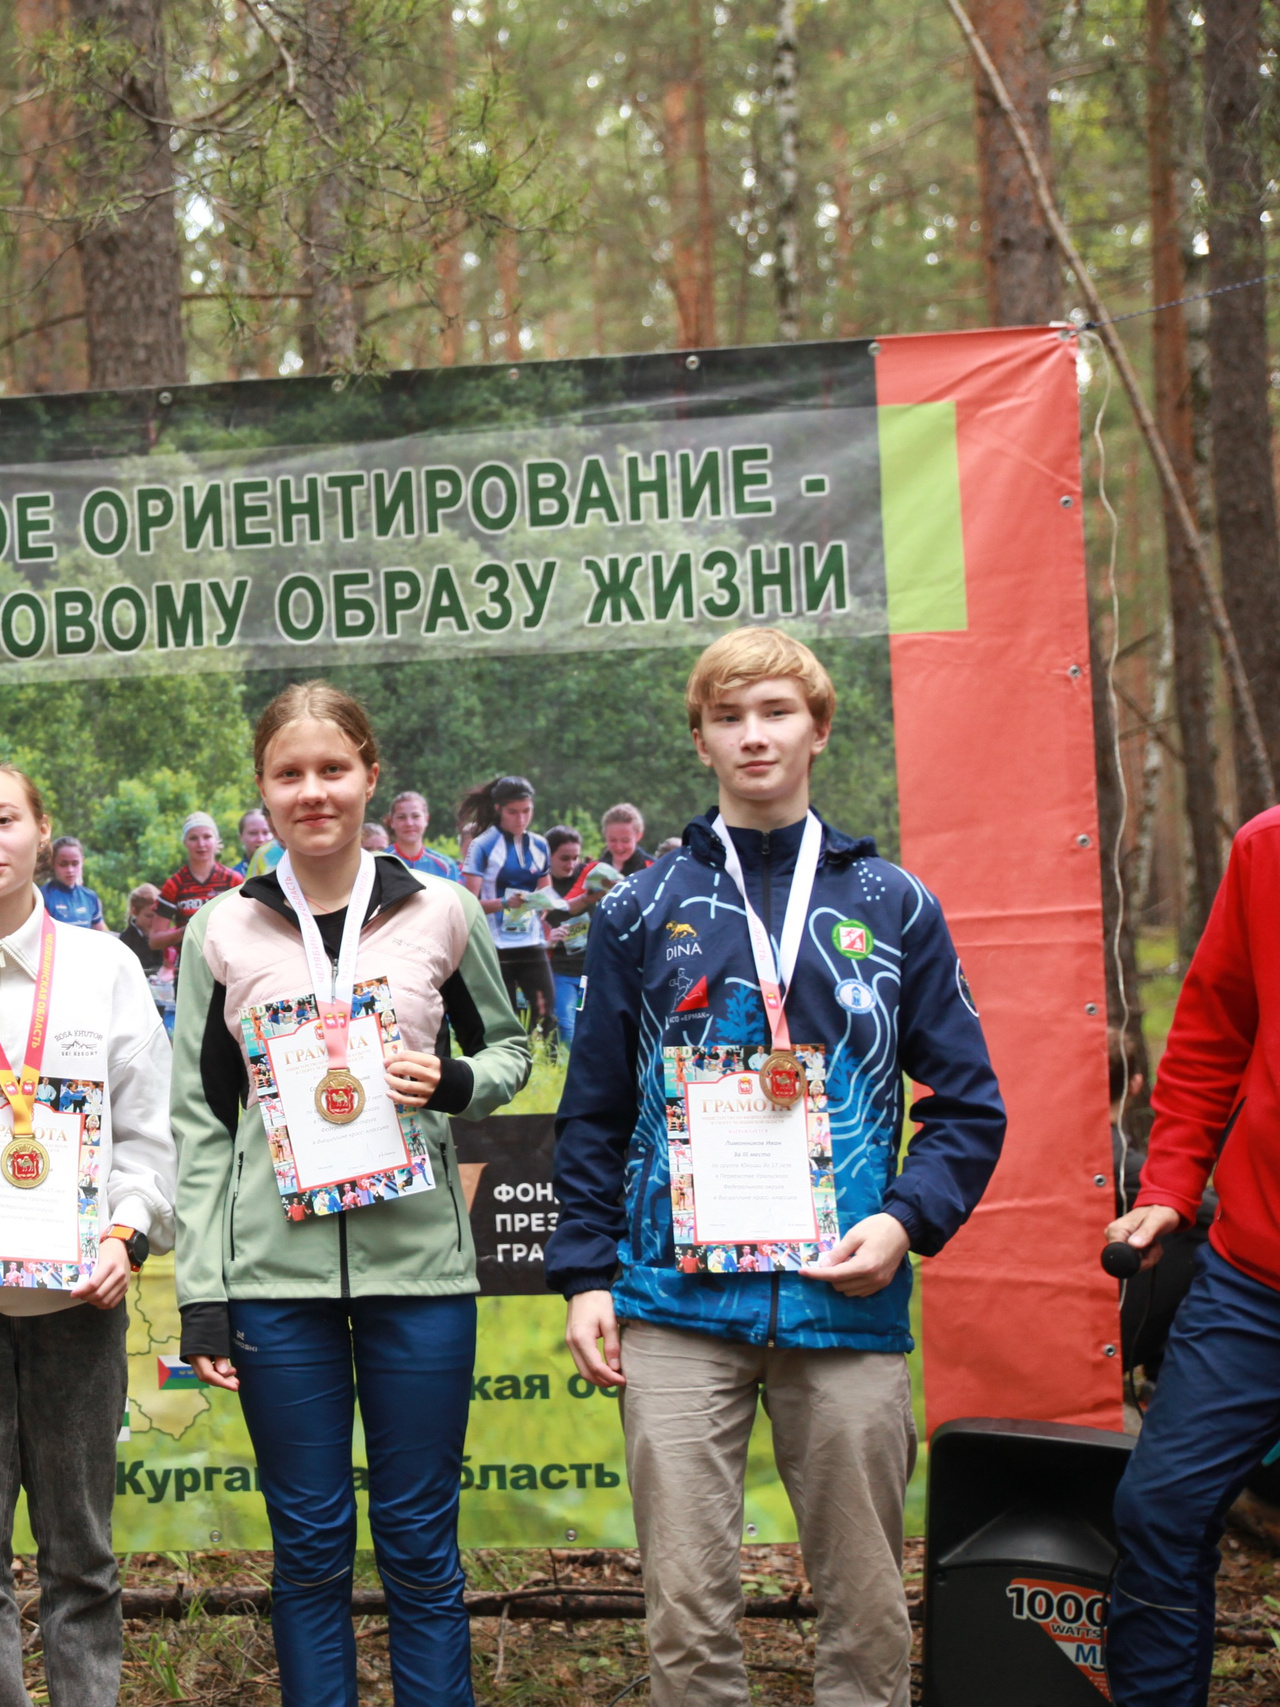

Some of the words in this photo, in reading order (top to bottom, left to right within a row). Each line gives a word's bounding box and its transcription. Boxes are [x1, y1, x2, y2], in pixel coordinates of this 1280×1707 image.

[81, 443, 775, 558] ОРИЕНТИРОВАНИЕ
[277, 557, 558, 643] ОБРАЗУ
[584, 540, 850, 627] ЖИЗНИ
[284, 875, 306, 912] ОБЛАСТЬ
[36, 933, 54, 1003] ЧЕЛЯБИНСКАЯ
[666, 942, 703, 961] DINA
[31, 1004, 48, 1049] ОБЛАСТЬ
[74, 1030, 103, 1041] KHUTOR
[283, 1035, 368, 1065] ГРАМТА
